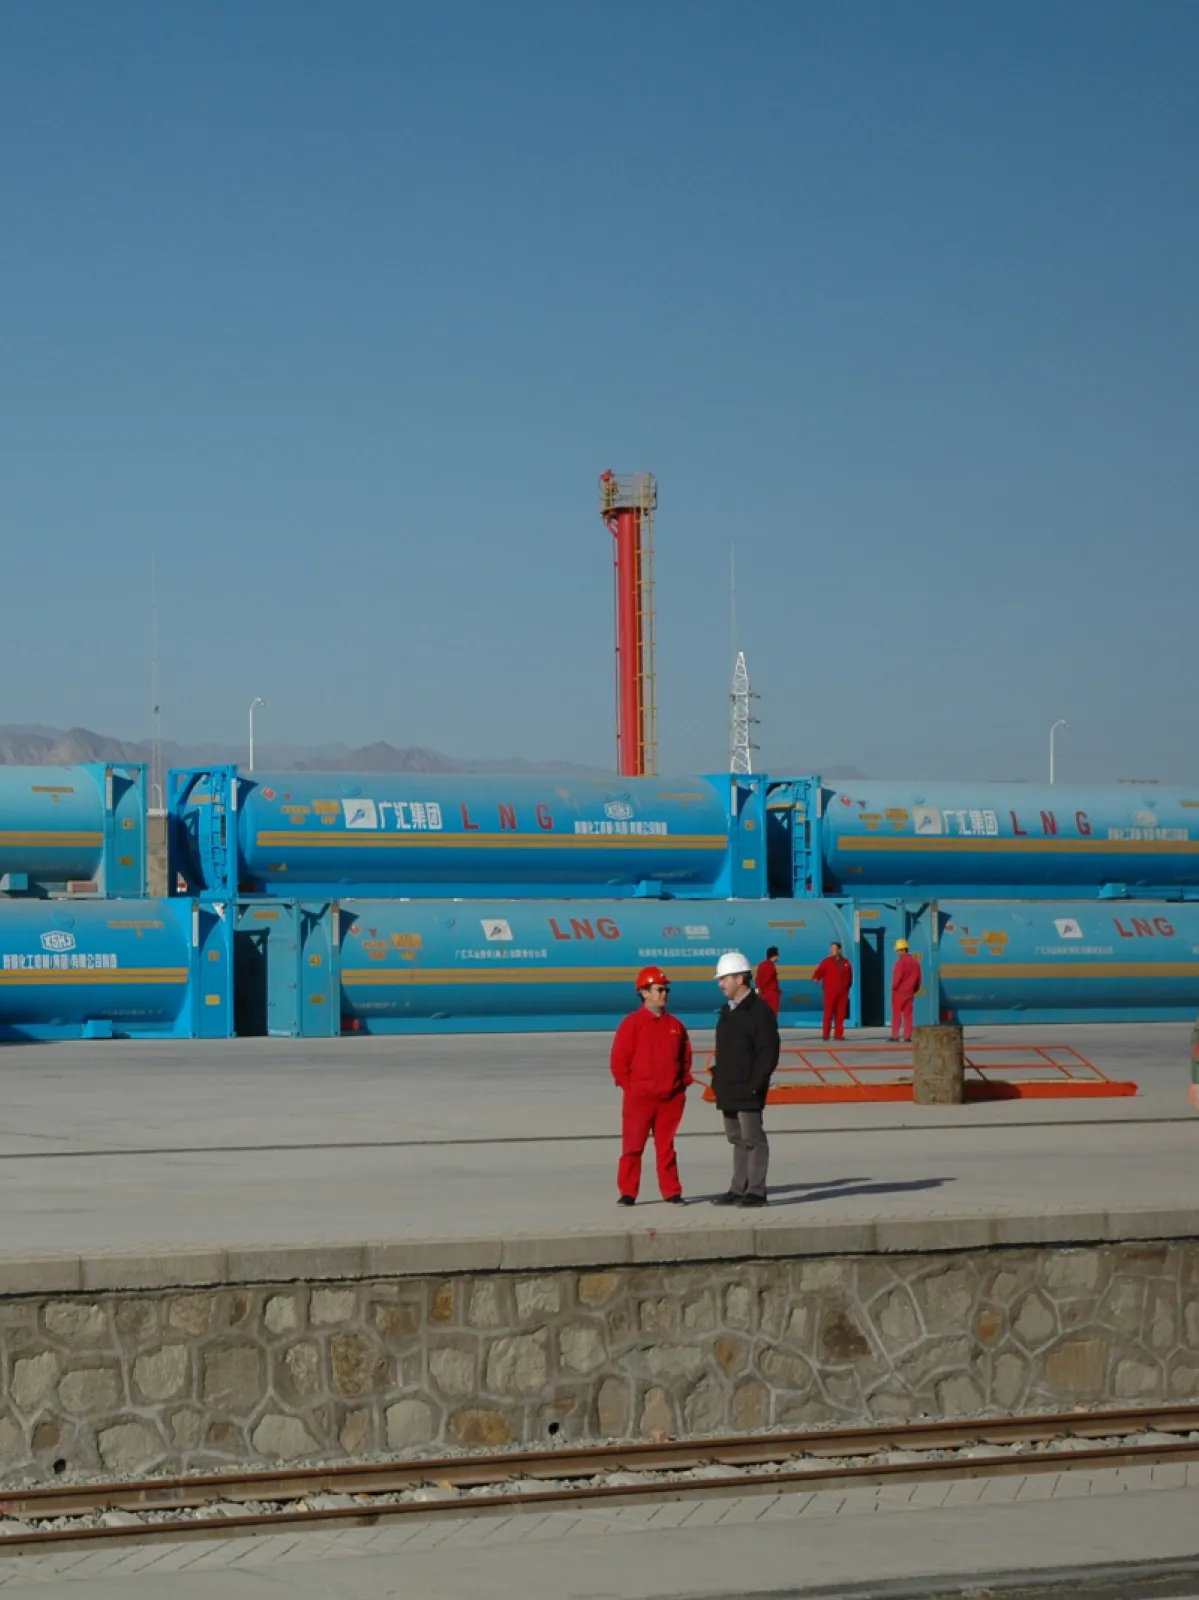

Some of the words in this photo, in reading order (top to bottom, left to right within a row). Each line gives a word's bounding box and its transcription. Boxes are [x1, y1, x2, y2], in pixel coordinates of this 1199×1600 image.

[378, 801, 443, 830] 广汇集团
[461, 804, 554, 830] LNG
[942, 809, 999, 836] 广汇集团
[1009, 811, 1091, 836] LNG
[549, 918, 620, 940] LNG
[1113, 917, 1175, 937] LNG
